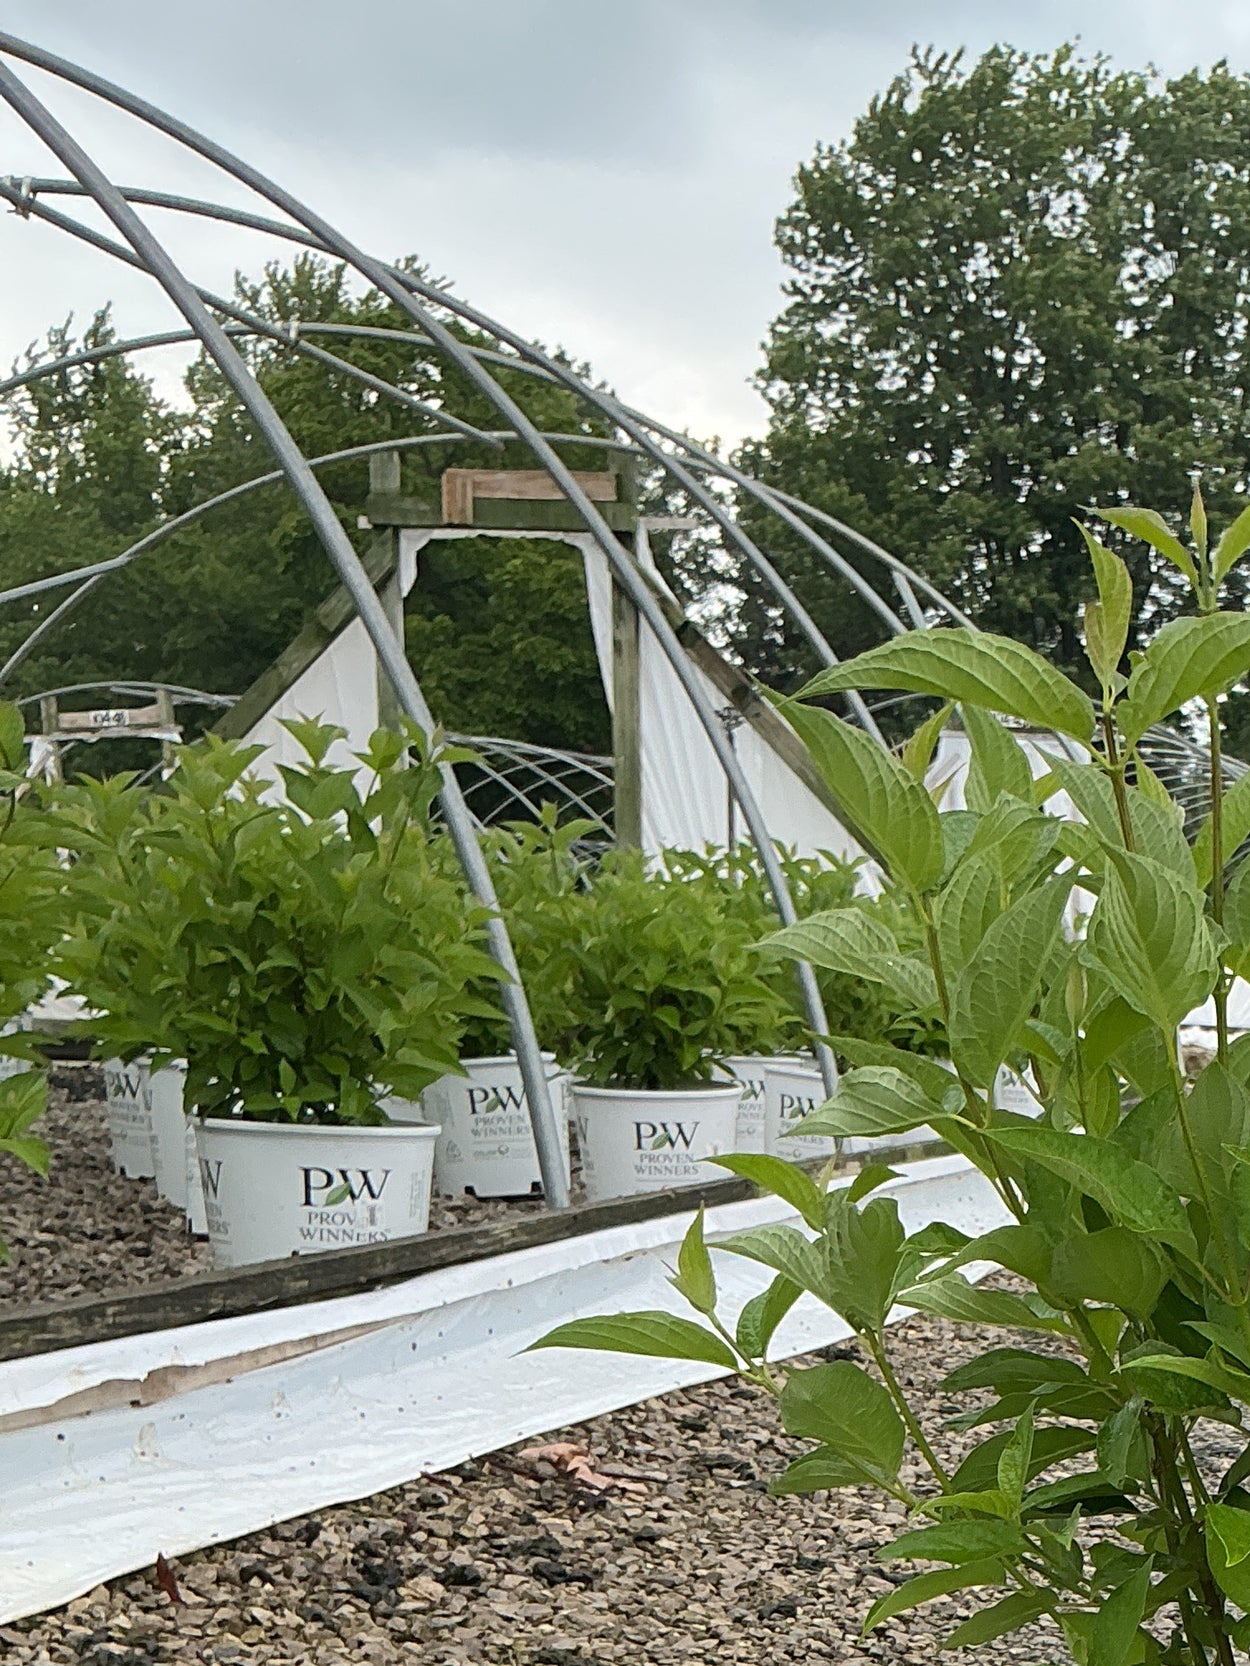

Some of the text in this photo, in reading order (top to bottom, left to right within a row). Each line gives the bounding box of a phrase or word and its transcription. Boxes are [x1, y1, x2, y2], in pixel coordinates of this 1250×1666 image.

[467, 1086, 525, 1115] PW
[633, 1121, 700, 1150] PW
[299, 1166, 392, 1207] PW
